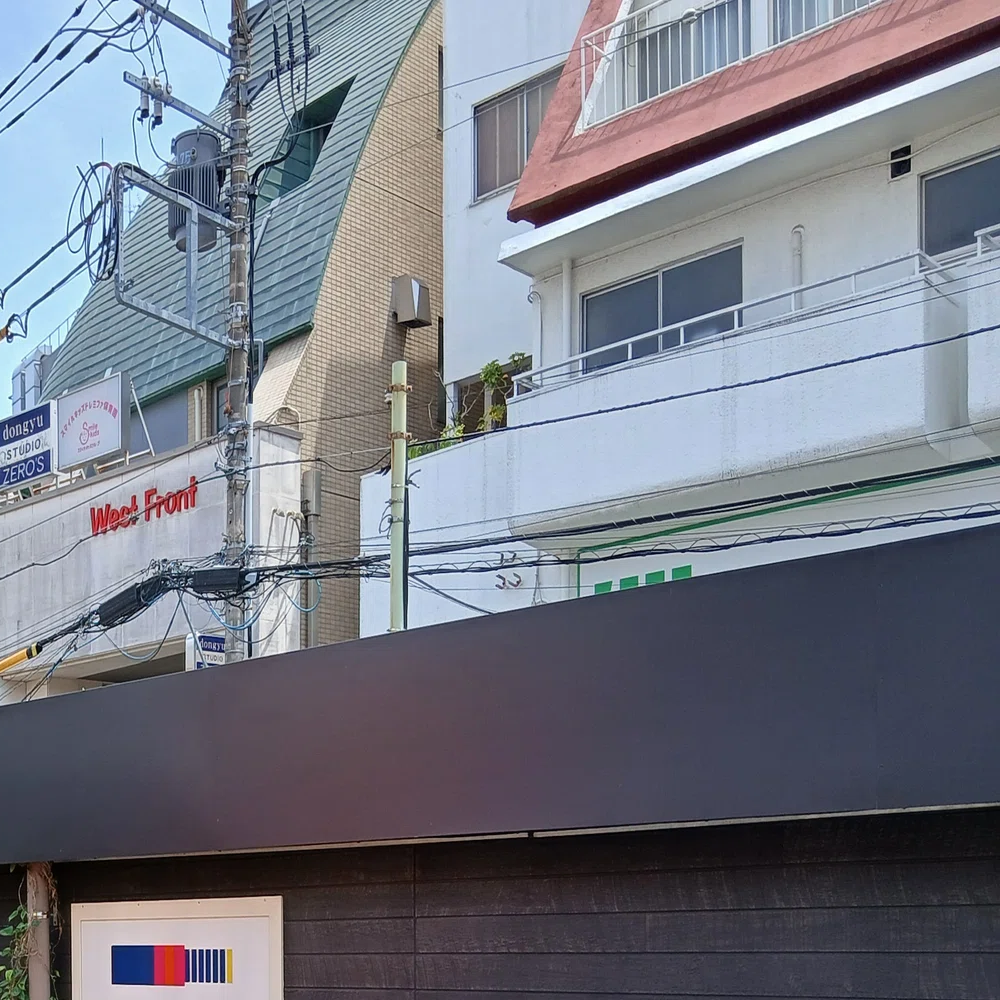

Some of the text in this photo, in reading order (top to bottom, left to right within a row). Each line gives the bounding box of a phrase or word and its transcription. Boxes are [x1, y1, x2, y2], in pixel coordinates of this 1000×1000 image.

[2, 414, 44, 441] dongyu
[6, 438, 41, 460] STUDIO
[2, 455, 45, 485] ZERO'S
[90, 475, 198, 536] West Front
